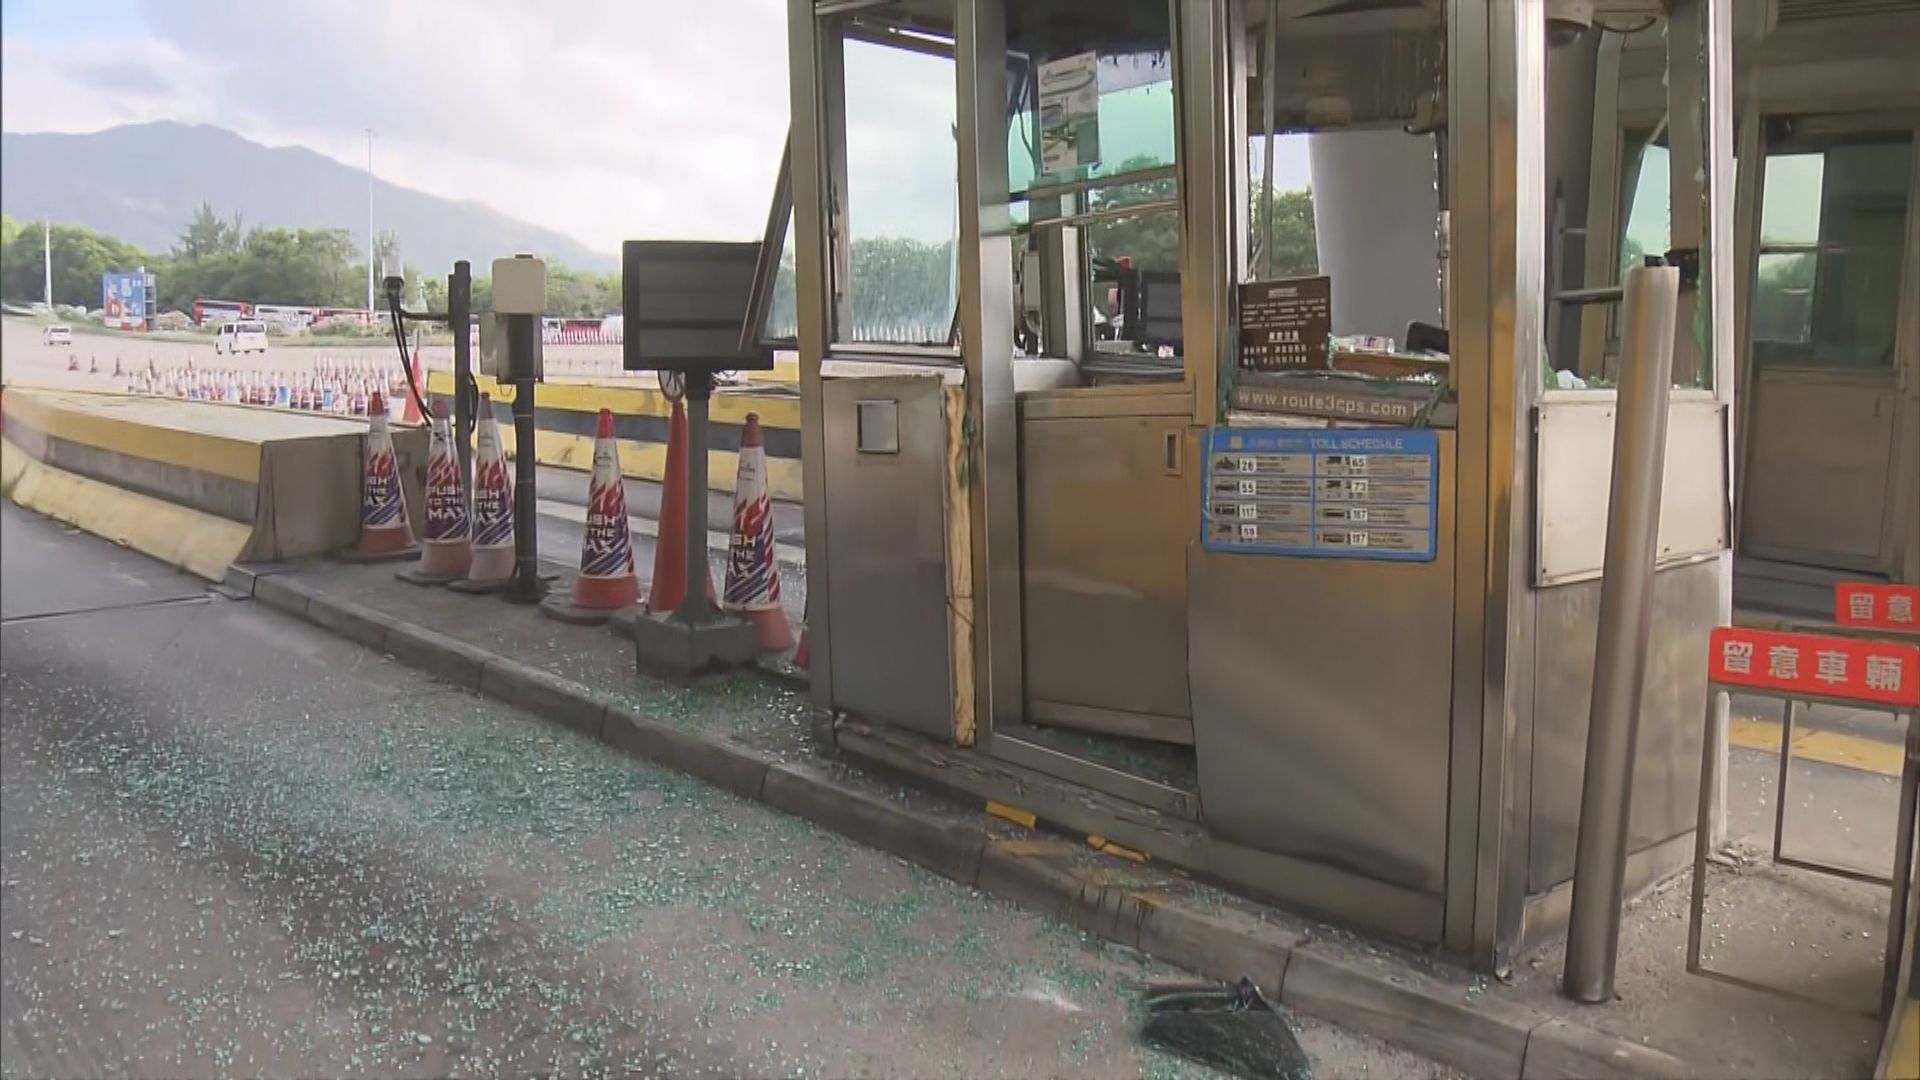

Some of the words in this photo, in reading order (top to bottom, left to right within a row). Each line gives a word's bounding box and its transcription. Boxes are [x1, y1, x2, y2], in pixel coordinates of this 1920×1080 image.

[1238, 390, 1407, 416] www.route3cps.com
[1311, 438, 1338, 449] TOLL
[1340, 438, 1403, 449] SCHEDULE
[1722, 639, 1903, 691] 留意車輛
